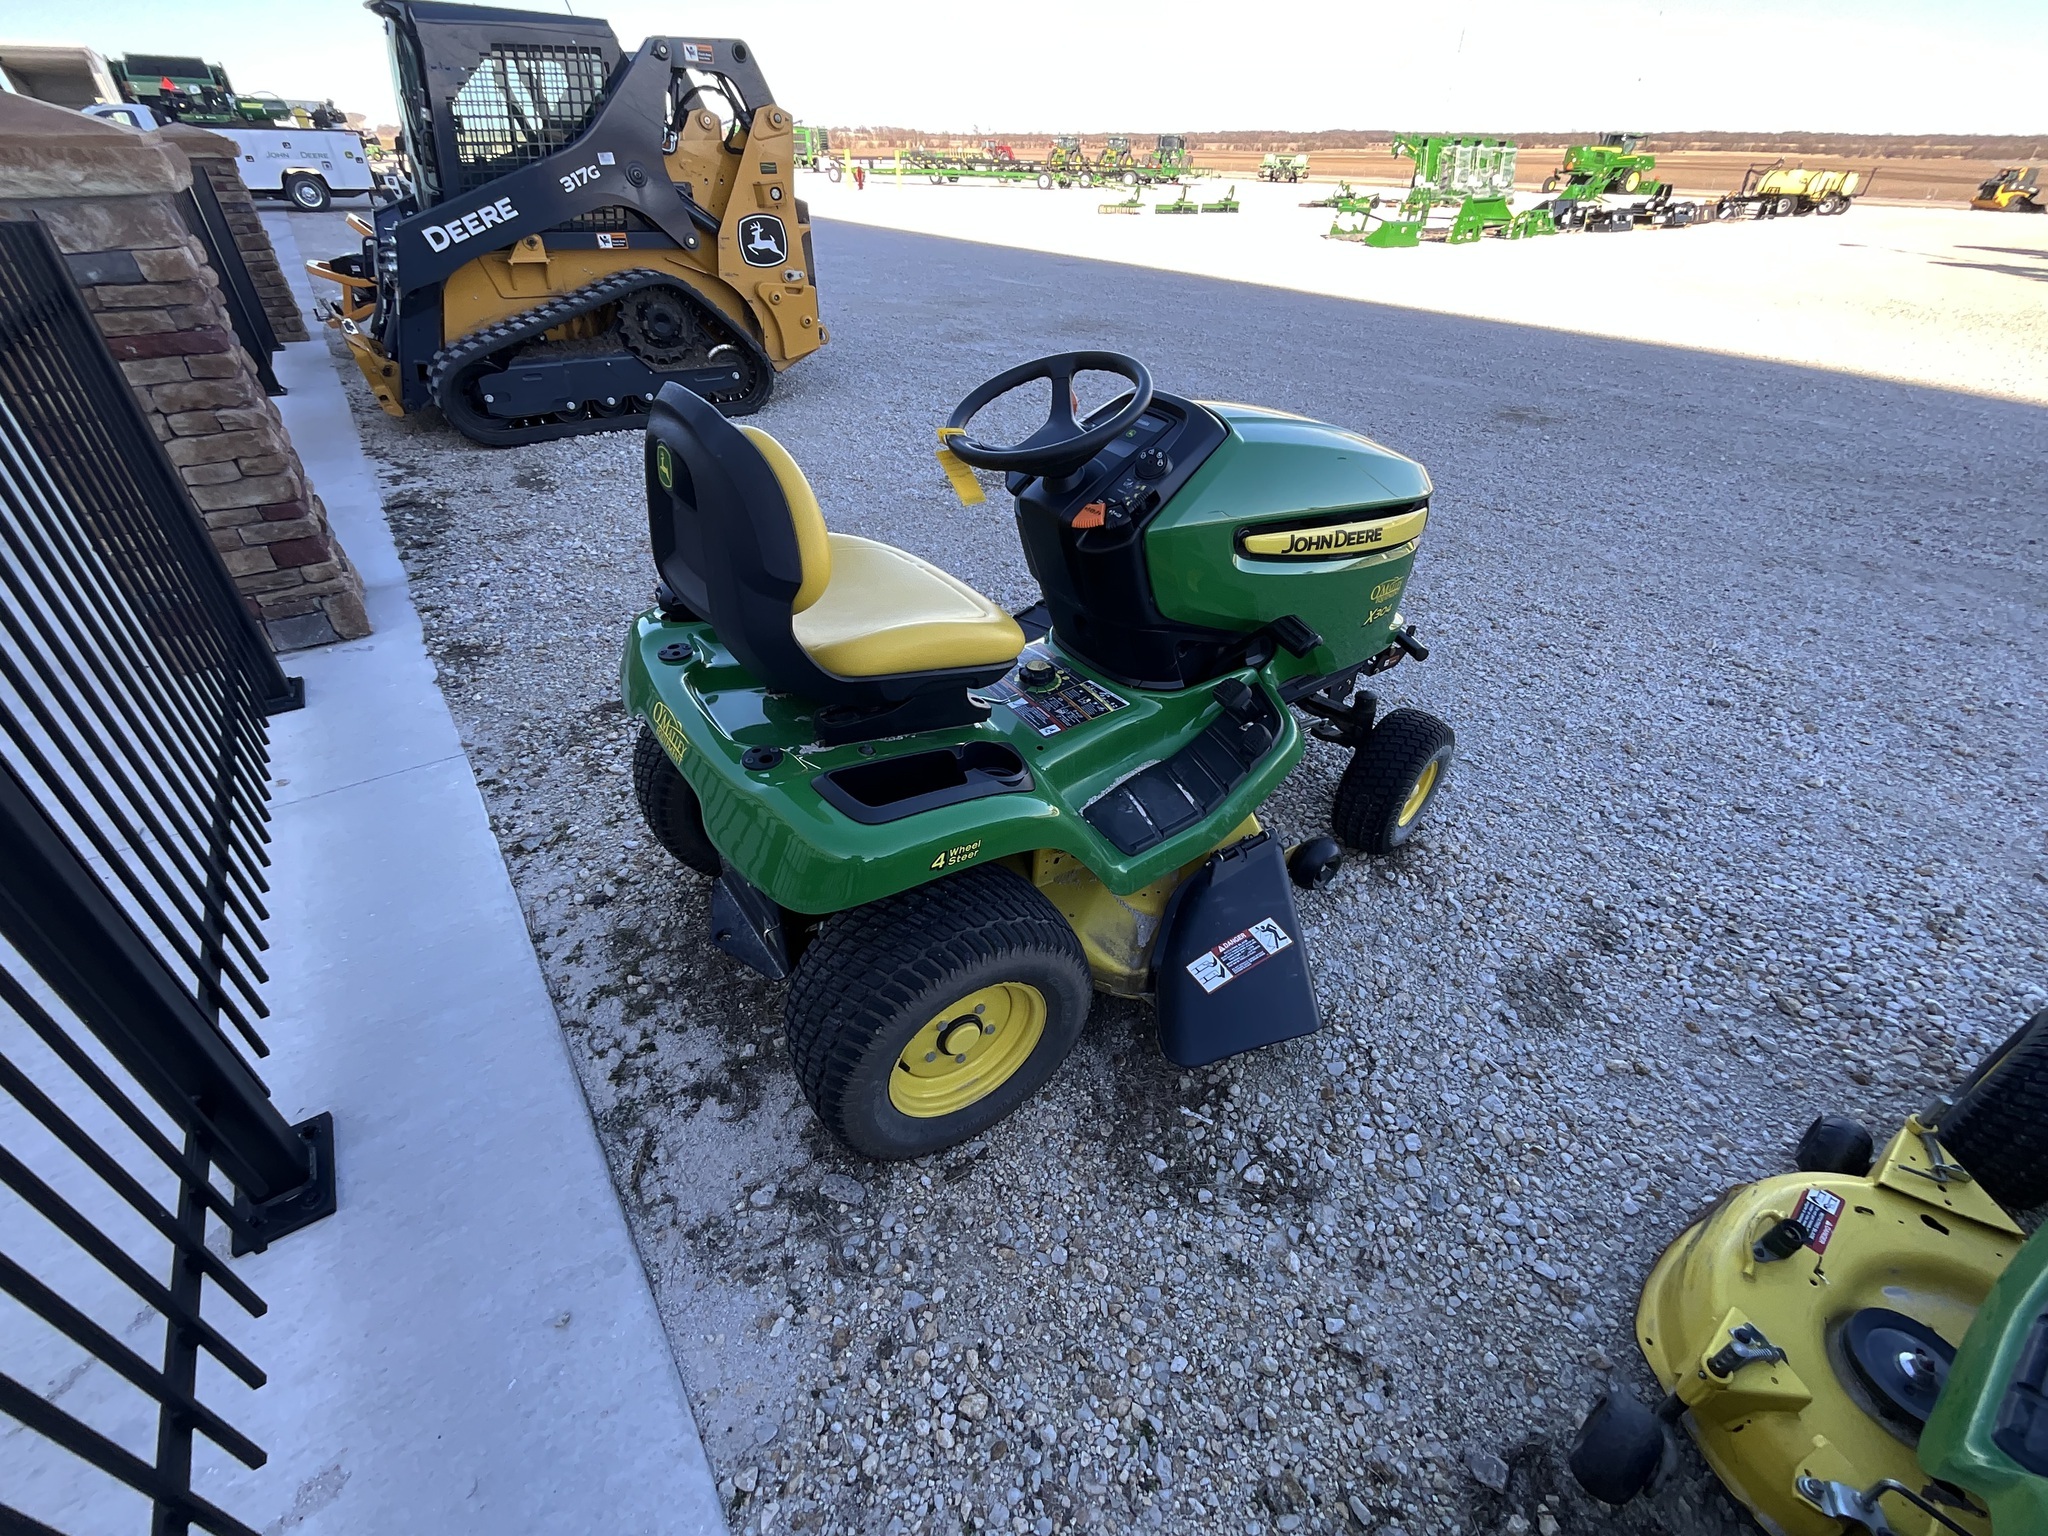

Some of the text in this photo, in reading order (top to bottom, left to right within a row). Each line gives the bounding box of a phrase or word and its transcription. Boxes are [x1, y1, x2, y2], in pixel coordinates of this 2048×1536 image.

[266, 151, 329, 159] JOHN DEERE
[559, 164, 601, 193] 317G
[421, 196, 519, 253] DEERE
[1281, 528, 1383, 554] JOHN DEERE
[930, 839, 982, 870] 4 Wheel
[948, 849, 979, 866] Steer
[1222, 932, 1247, 949] DANGER
